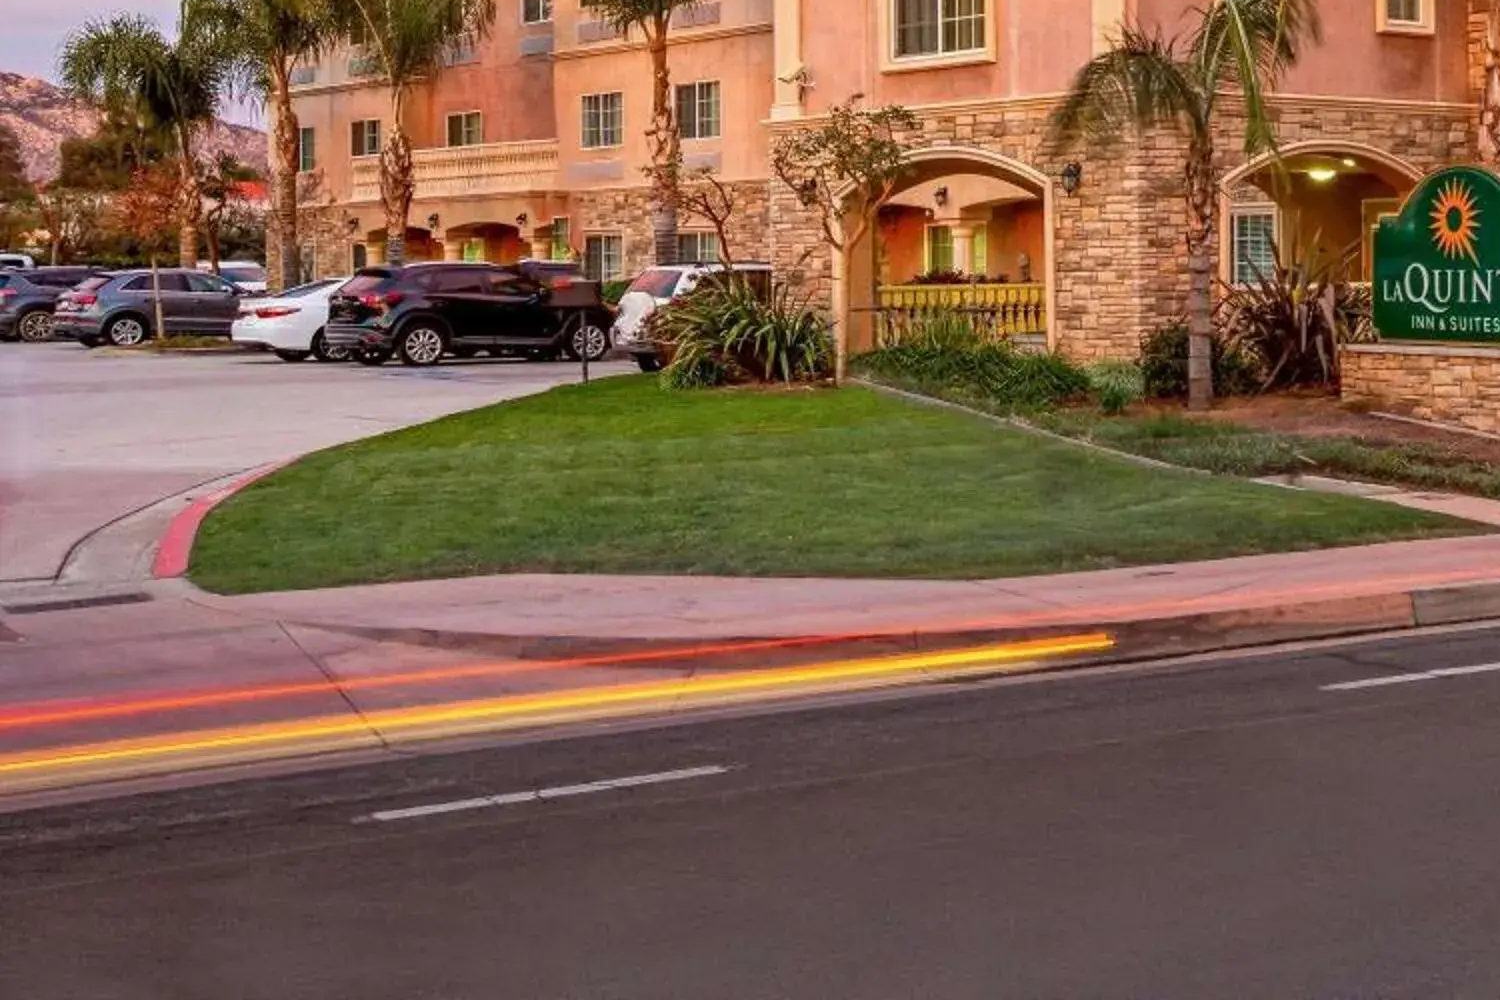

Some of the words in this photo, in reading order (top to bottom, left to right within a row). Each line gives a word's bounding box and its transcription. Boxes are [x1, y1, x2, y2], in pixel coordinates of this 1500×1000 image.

[1383, 279, 1403, 302] LA
[1411, 314, 1435, 331] INN
[1449, 315, 1500, 333] SUITES
